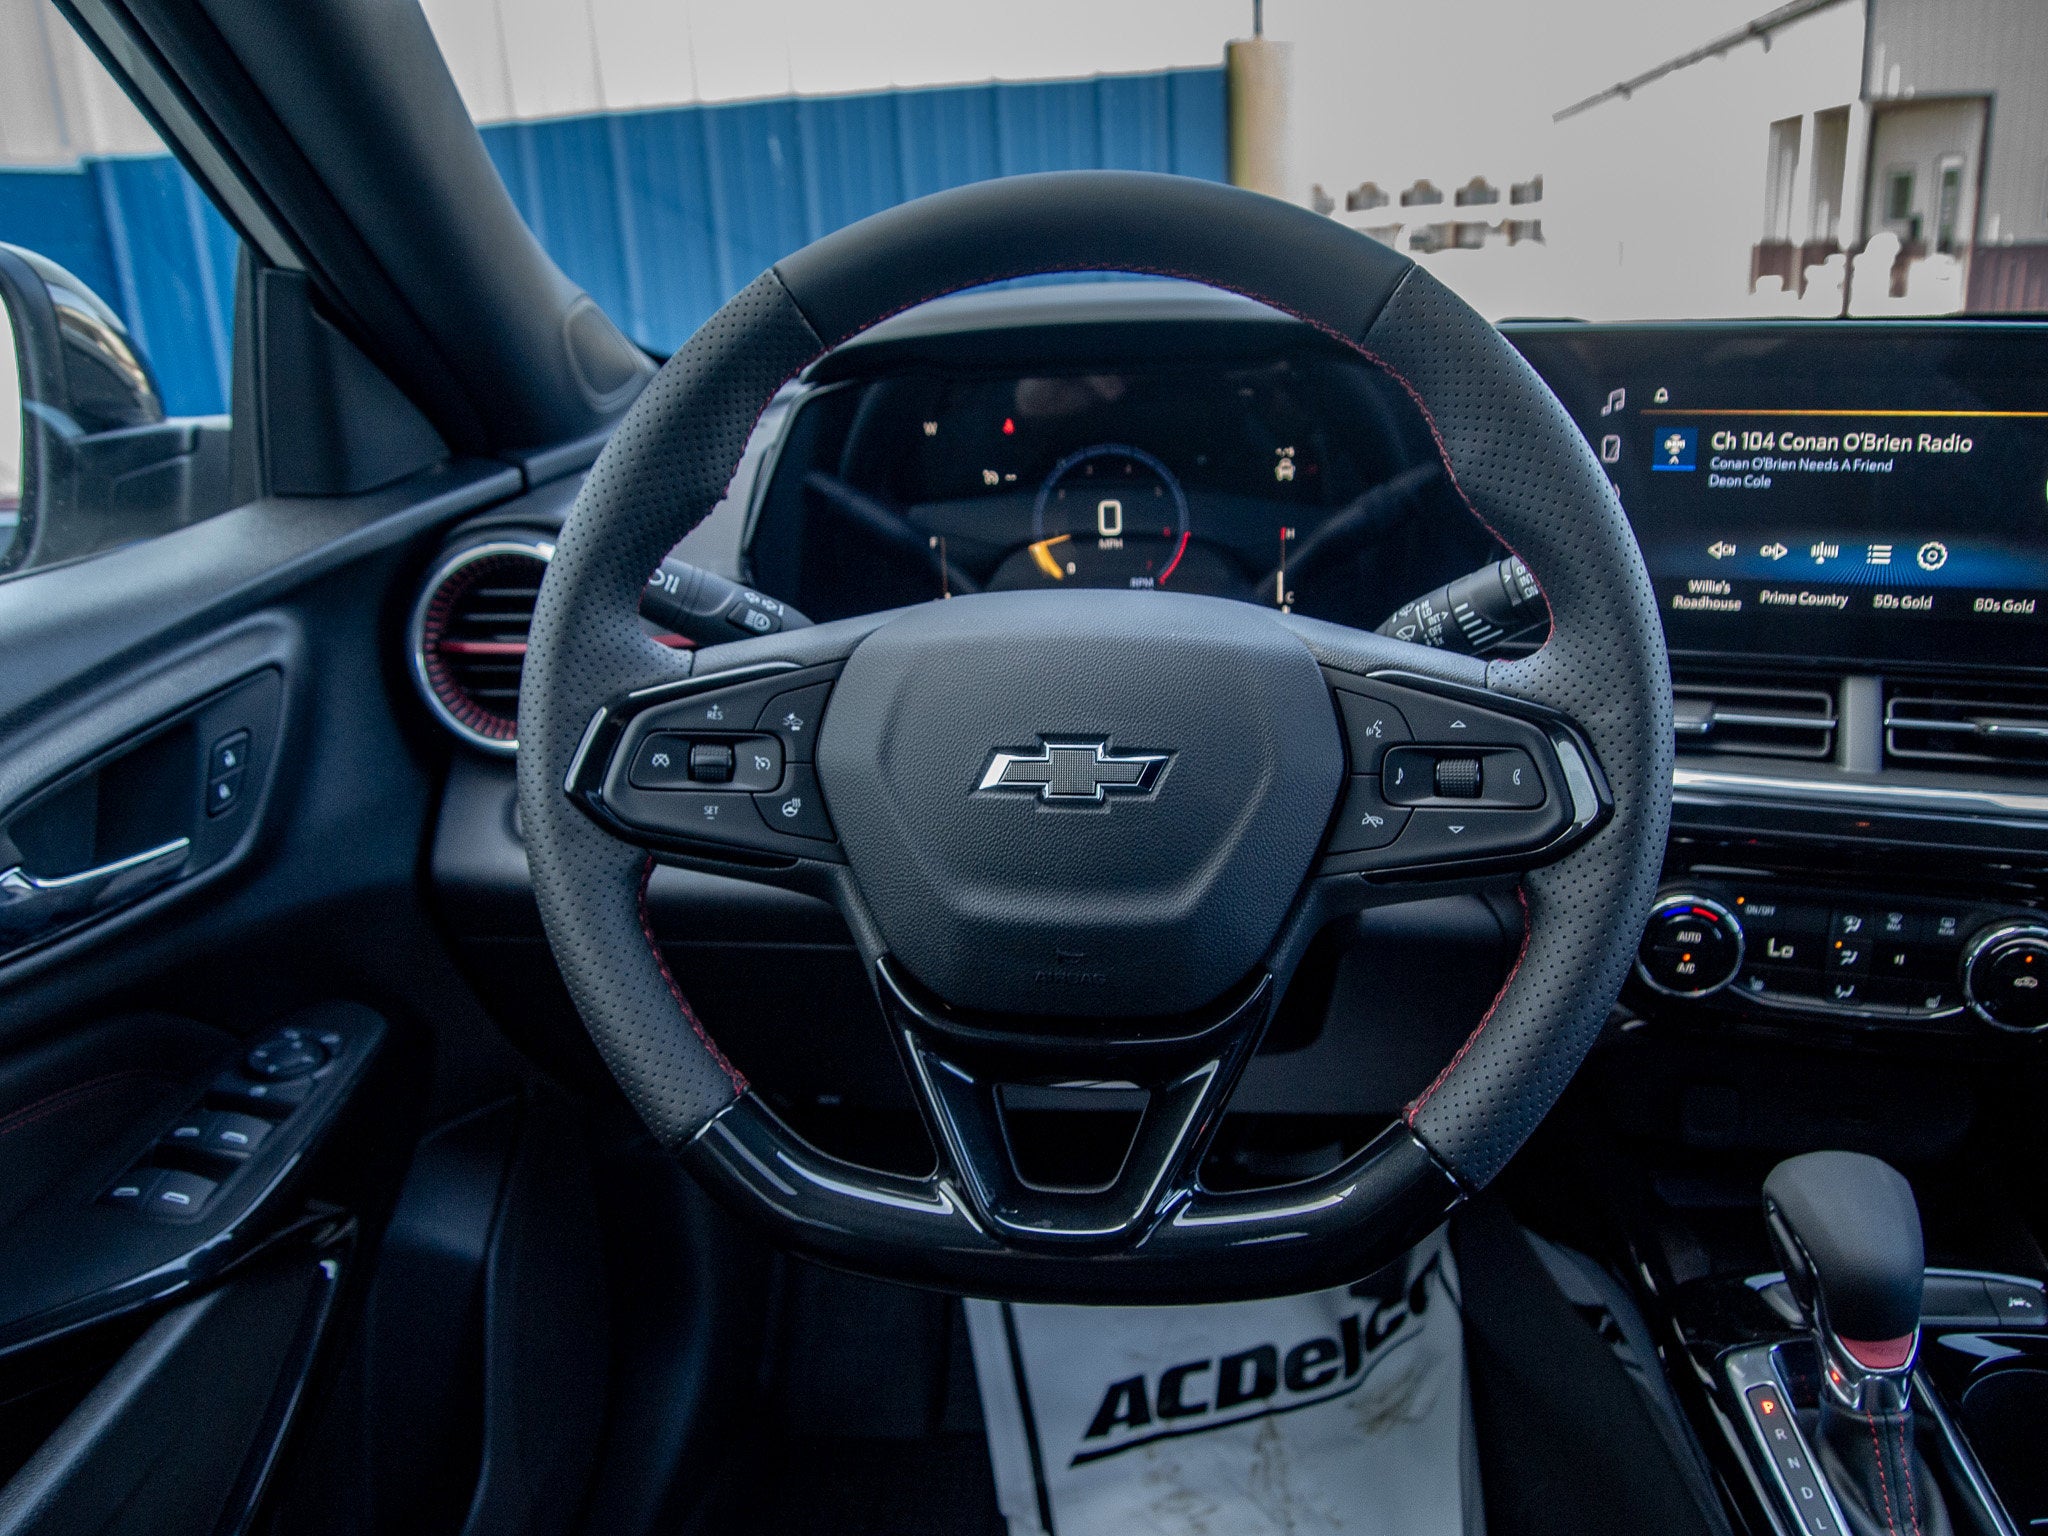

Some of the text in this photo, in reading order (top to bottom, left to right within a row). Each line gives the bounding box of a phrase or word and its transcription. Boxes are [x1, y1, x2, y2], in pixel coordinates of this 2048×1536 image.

[1711, 431, 1973, 454] Ch 104 Conan O'Brien Radio
[1710, 457, 1894, 473] Conan O'Brien Needs A Friend
[1708, 474, 1772, 489] Deon Cole
[1098, 499, 1122, 536] 0
[1688, 579, 1731, 595] Willie's
[1672, 594, 1742, 612] Roadhouse
[1760, 590, 1849, 610] Prime Country
[1900, 594, 1933, 611] Gold
[2002, 599, 2036, 614] Gold
[1427, 612, 1441, 626] INT
[1428, 623, 1442, 637] OFF
[706, 710, 723, 721] RES
[703, 805, 720, 816] SET
[1677, 931, 1702, 944] AUTO
[1676, 961, 1696, 975] A/C
[1761, 1400, 1775, 1415] P
[1774, 1427, 1788, 1441] R
[1787, 1456, 1800, 1470] N
[1801, 1486, 1814, 1500] D
[1816, 1517, 1827, 1531] L
